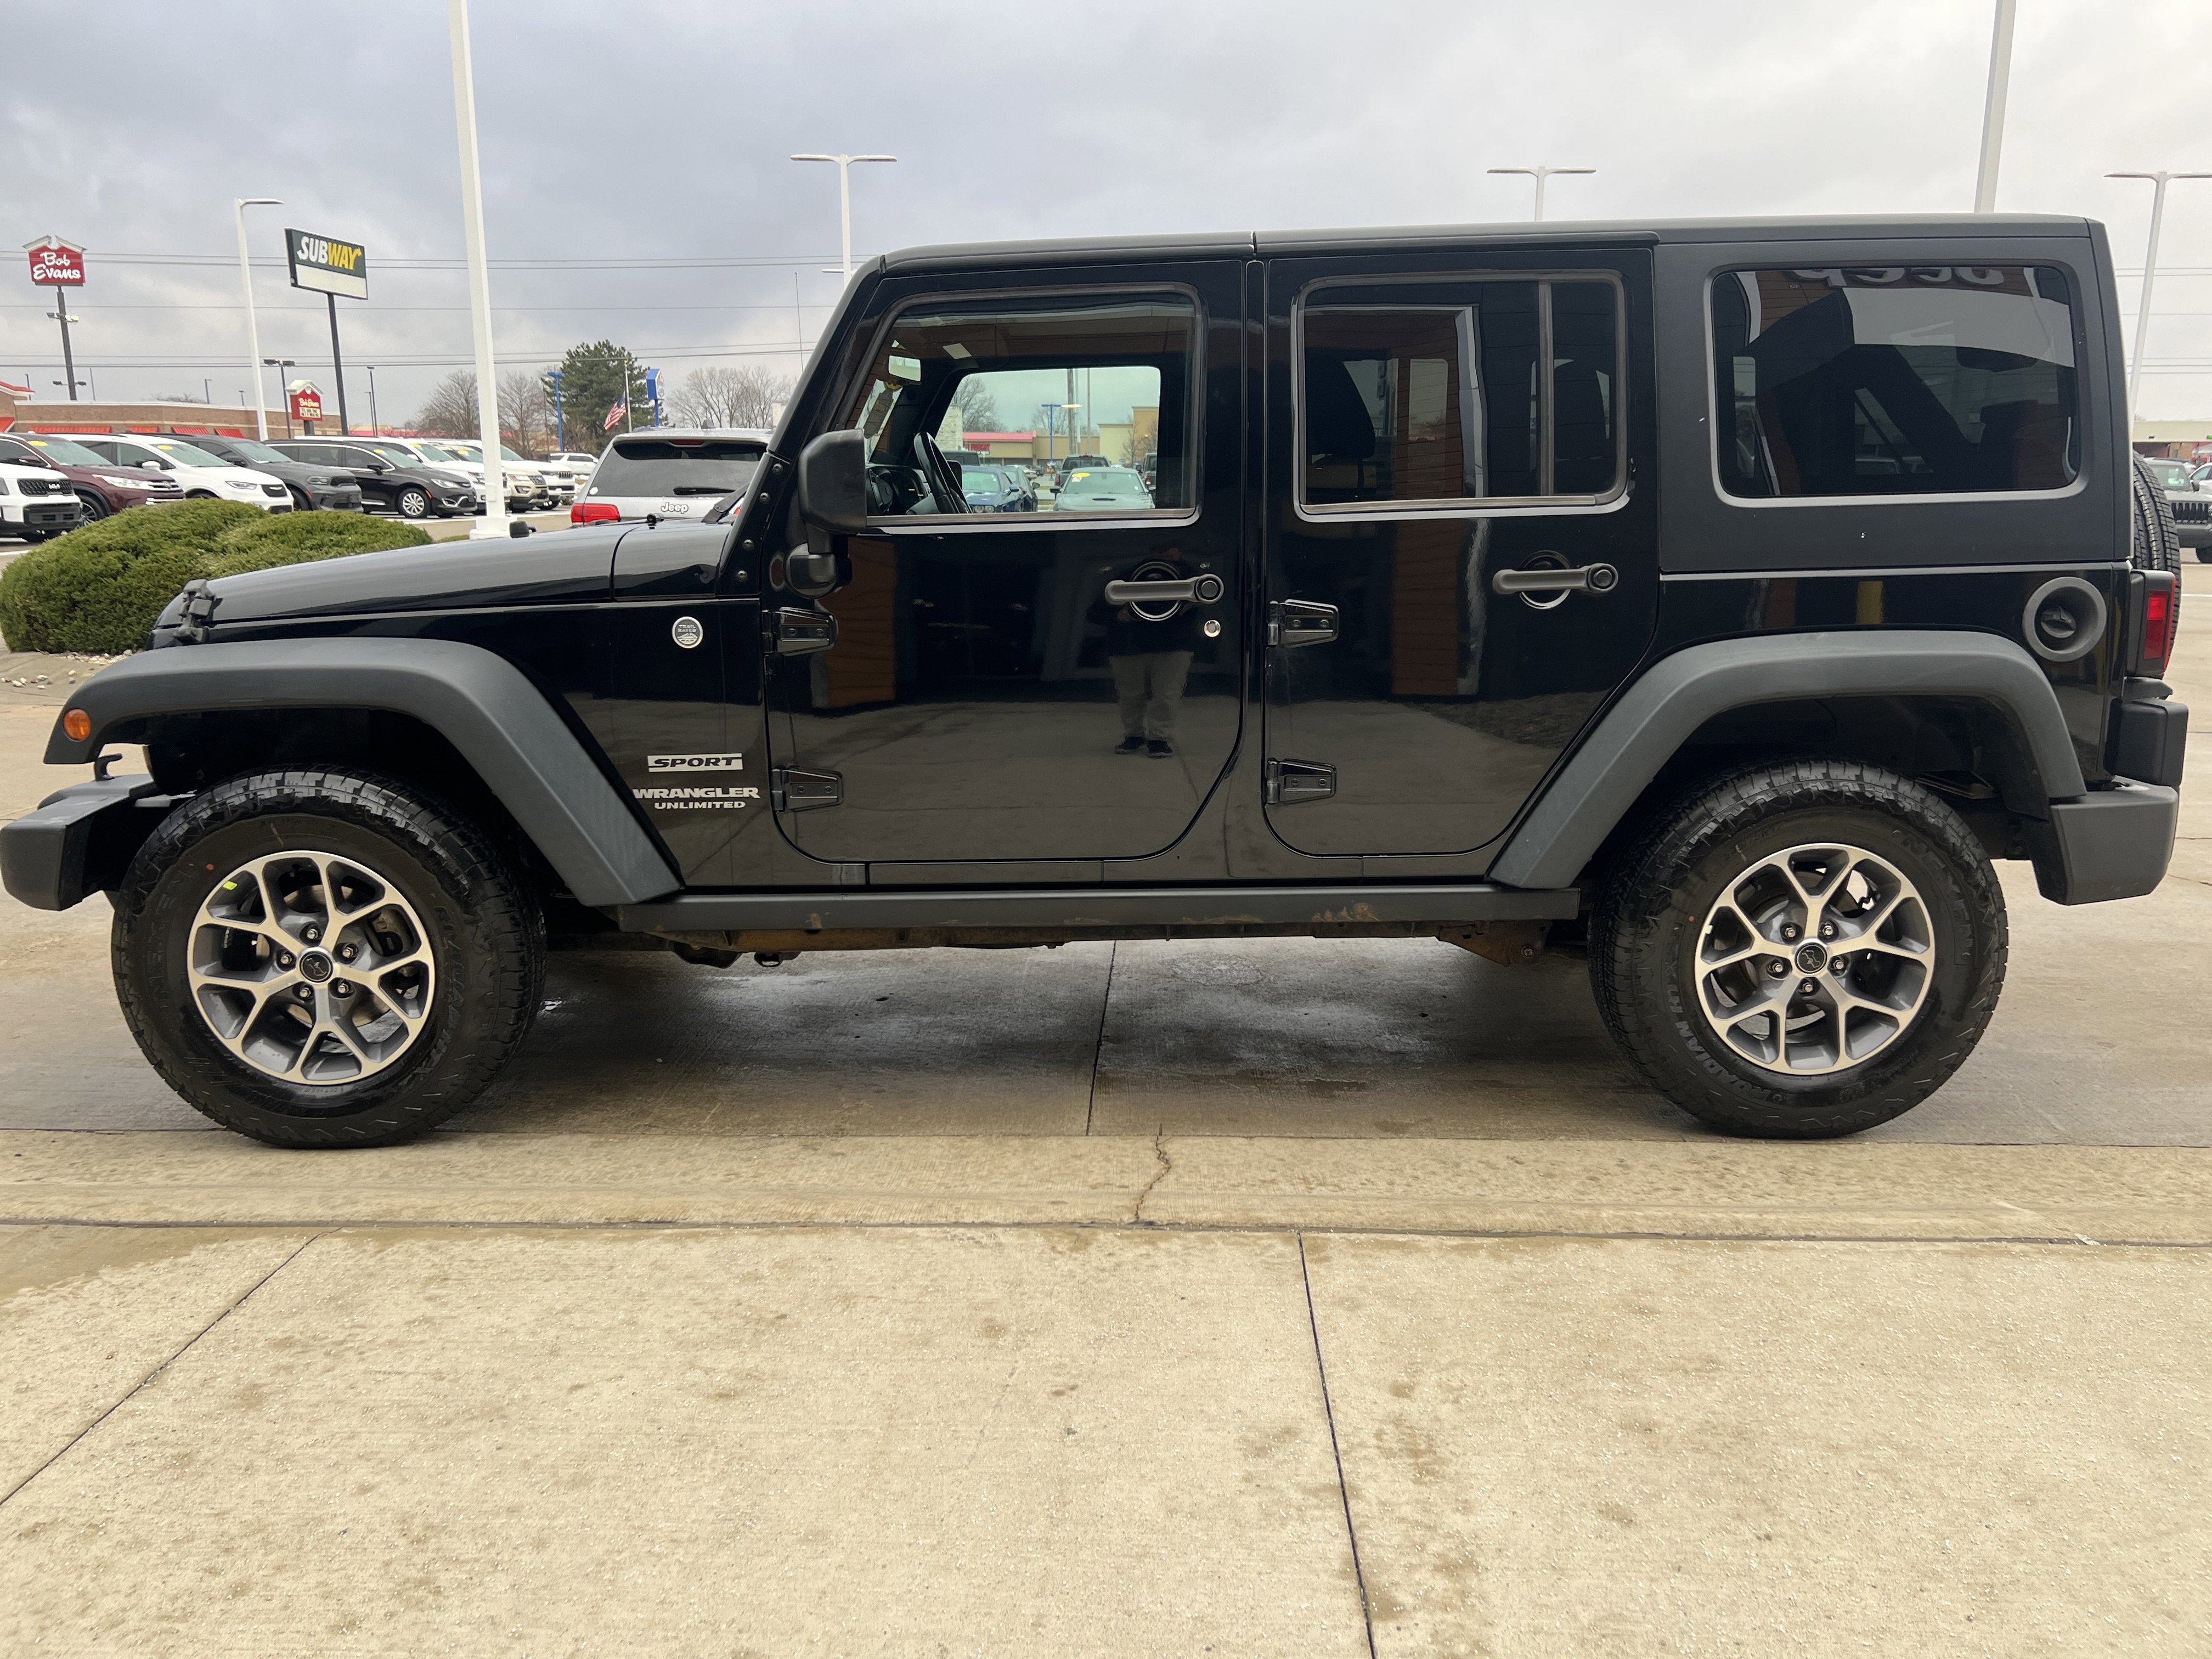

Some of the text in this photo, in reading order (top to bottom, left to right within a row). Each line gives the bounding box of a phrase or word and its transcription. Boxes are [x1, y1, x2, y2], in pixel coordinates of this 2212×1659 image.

[40, 251, 70, 266] Bob
[297, 236, 362, 270] SUBWAY
[32, 263, 81, 280] Evans
[661, 502, 689, 514] Jeep
[651, 757, 742, 768] SPORT
[632, 787, 761, 799] WRANGLER
[654, 801, 746, 809] UNLIMITED
